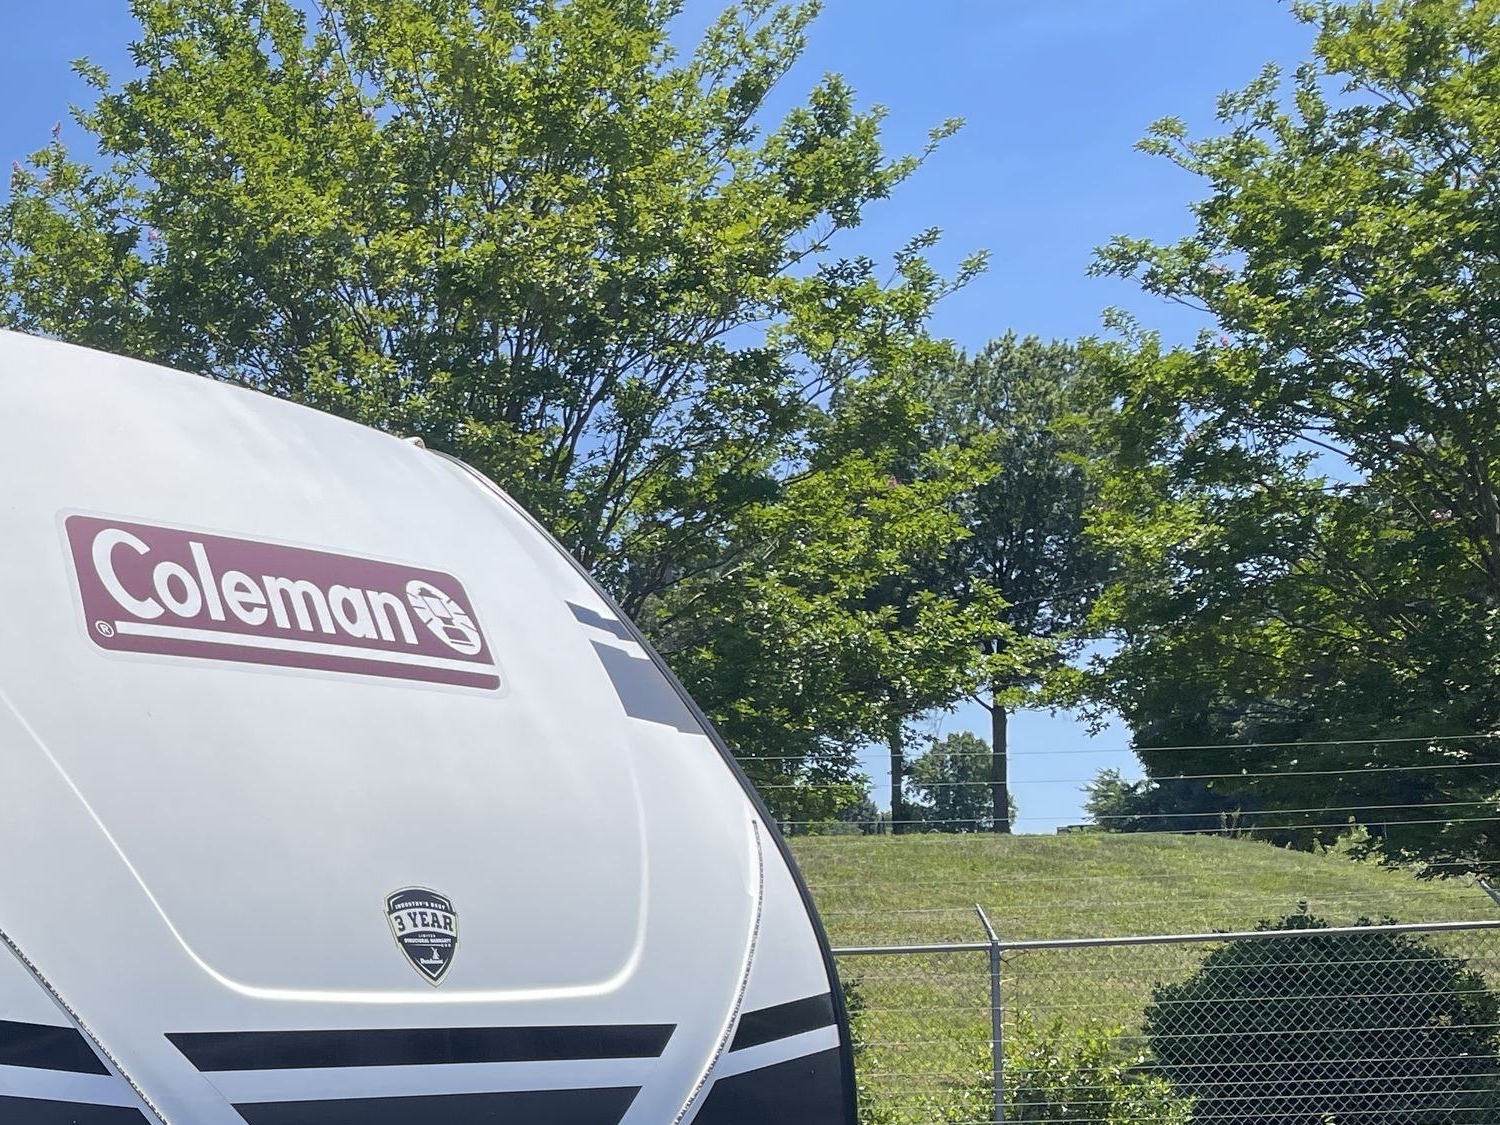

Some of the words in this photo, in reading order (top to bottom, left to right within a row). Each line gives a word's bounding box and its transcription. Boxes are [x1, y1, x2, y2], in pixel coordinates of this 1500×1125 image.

[91, 527, 419, 646] Coleman
[394, 914, 406, 933] 3
[407, 911, 454, 932] YEAR
